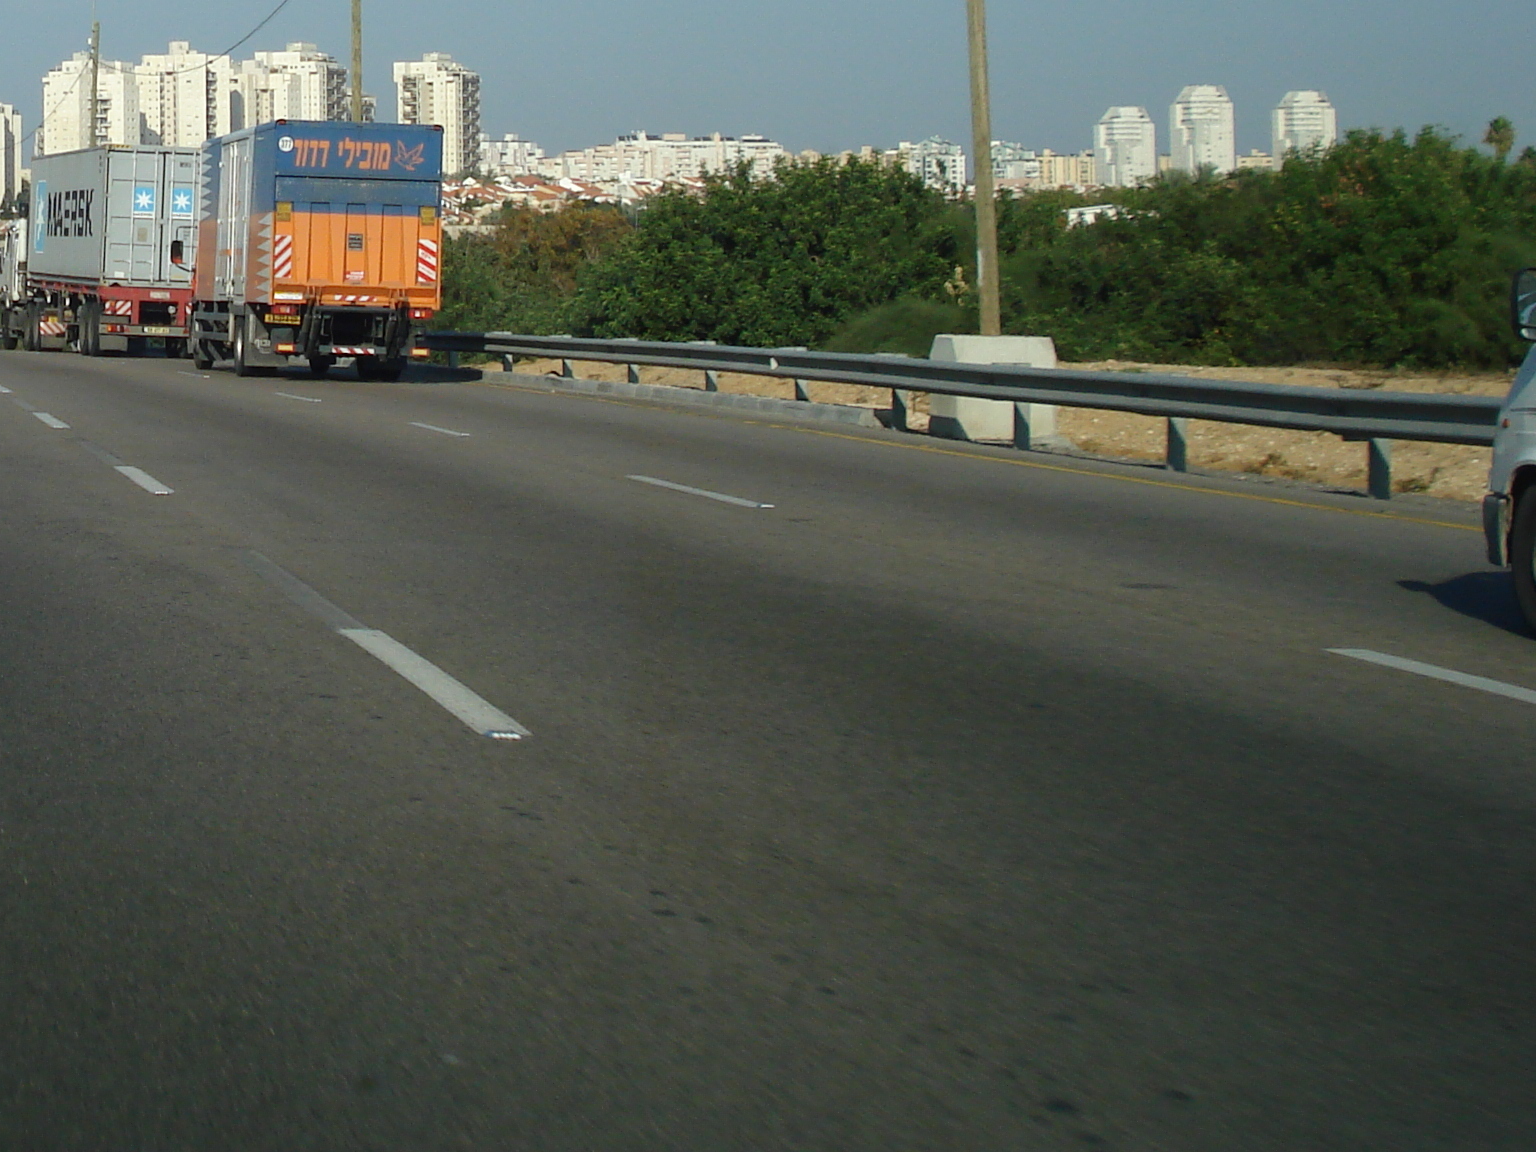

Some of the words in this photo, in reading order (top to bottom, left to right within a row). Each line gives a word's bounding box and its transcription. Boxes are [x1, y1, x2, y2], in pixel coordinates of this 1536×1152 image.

[294, 139, 330, 168] דרור
[338, 137, 392, 170] מובילי
[47, 188, 95, 237] MAERSK
